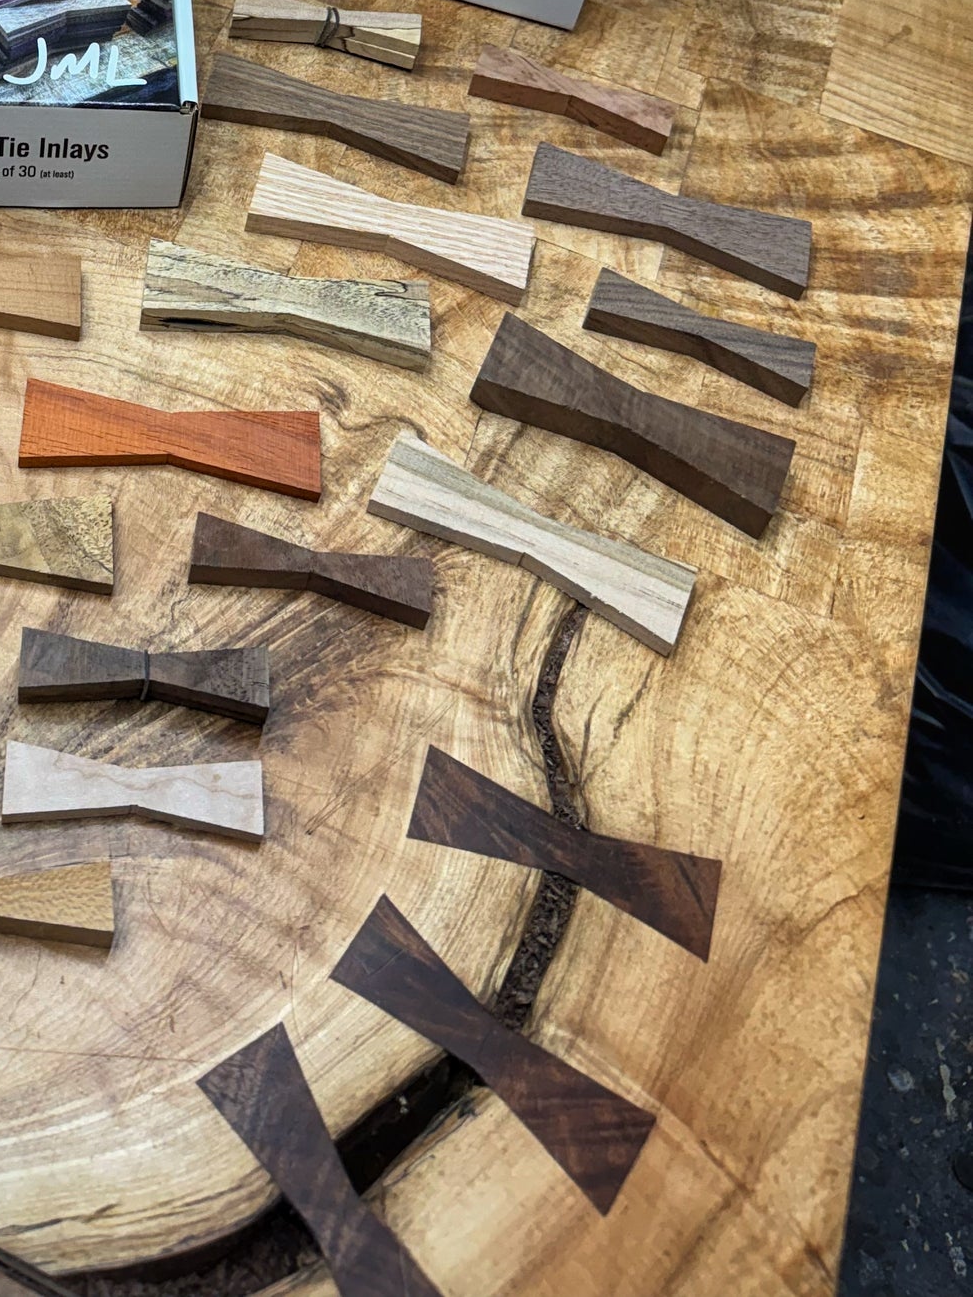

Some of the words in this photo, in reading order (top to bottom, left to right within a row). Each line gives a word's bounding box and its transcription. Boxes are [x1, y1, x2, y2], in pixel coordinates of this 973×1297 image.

[40, 138, 109, 162] Inlays
[2, 166, 15, 177] of
[19, 165, 36, 177] 30
[40, 170, 50, 178] (at
[53, 170, 74, 179] least)
